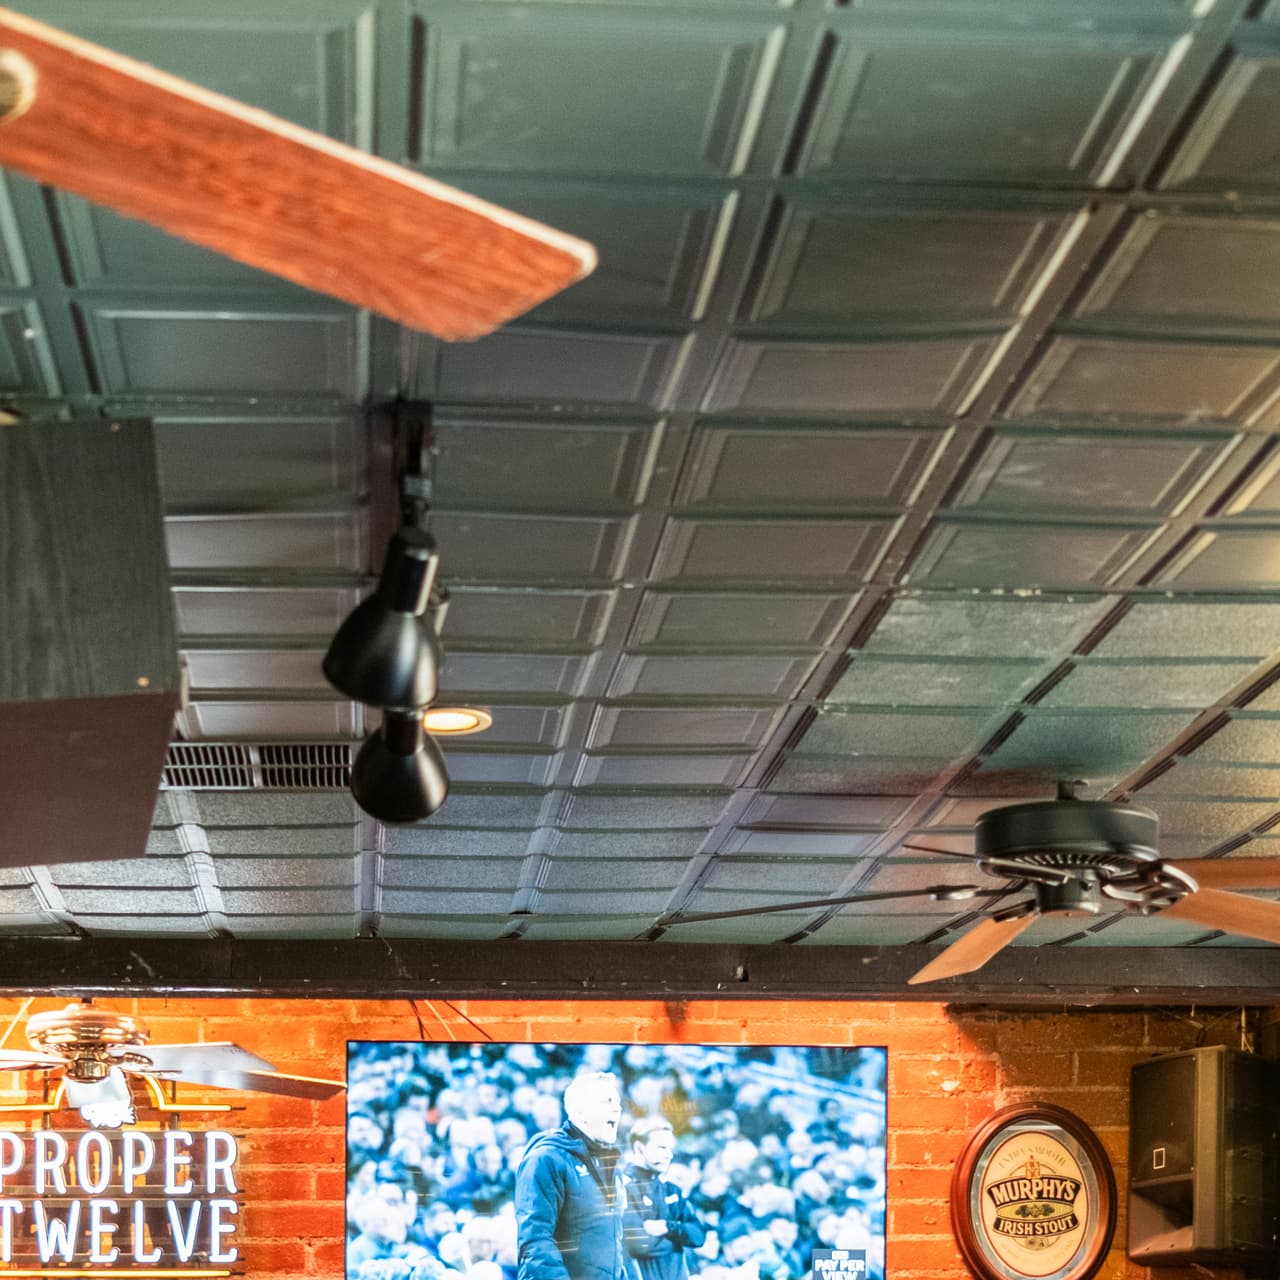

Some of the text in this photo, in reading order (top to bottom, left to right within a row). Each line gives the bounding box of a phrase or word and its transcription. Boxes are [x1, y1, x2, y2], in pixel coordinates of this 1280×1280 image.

[999, 1216, 1074, 1235] IRISH STOUT
[815, 1259, 865, 1271] PAY PER
